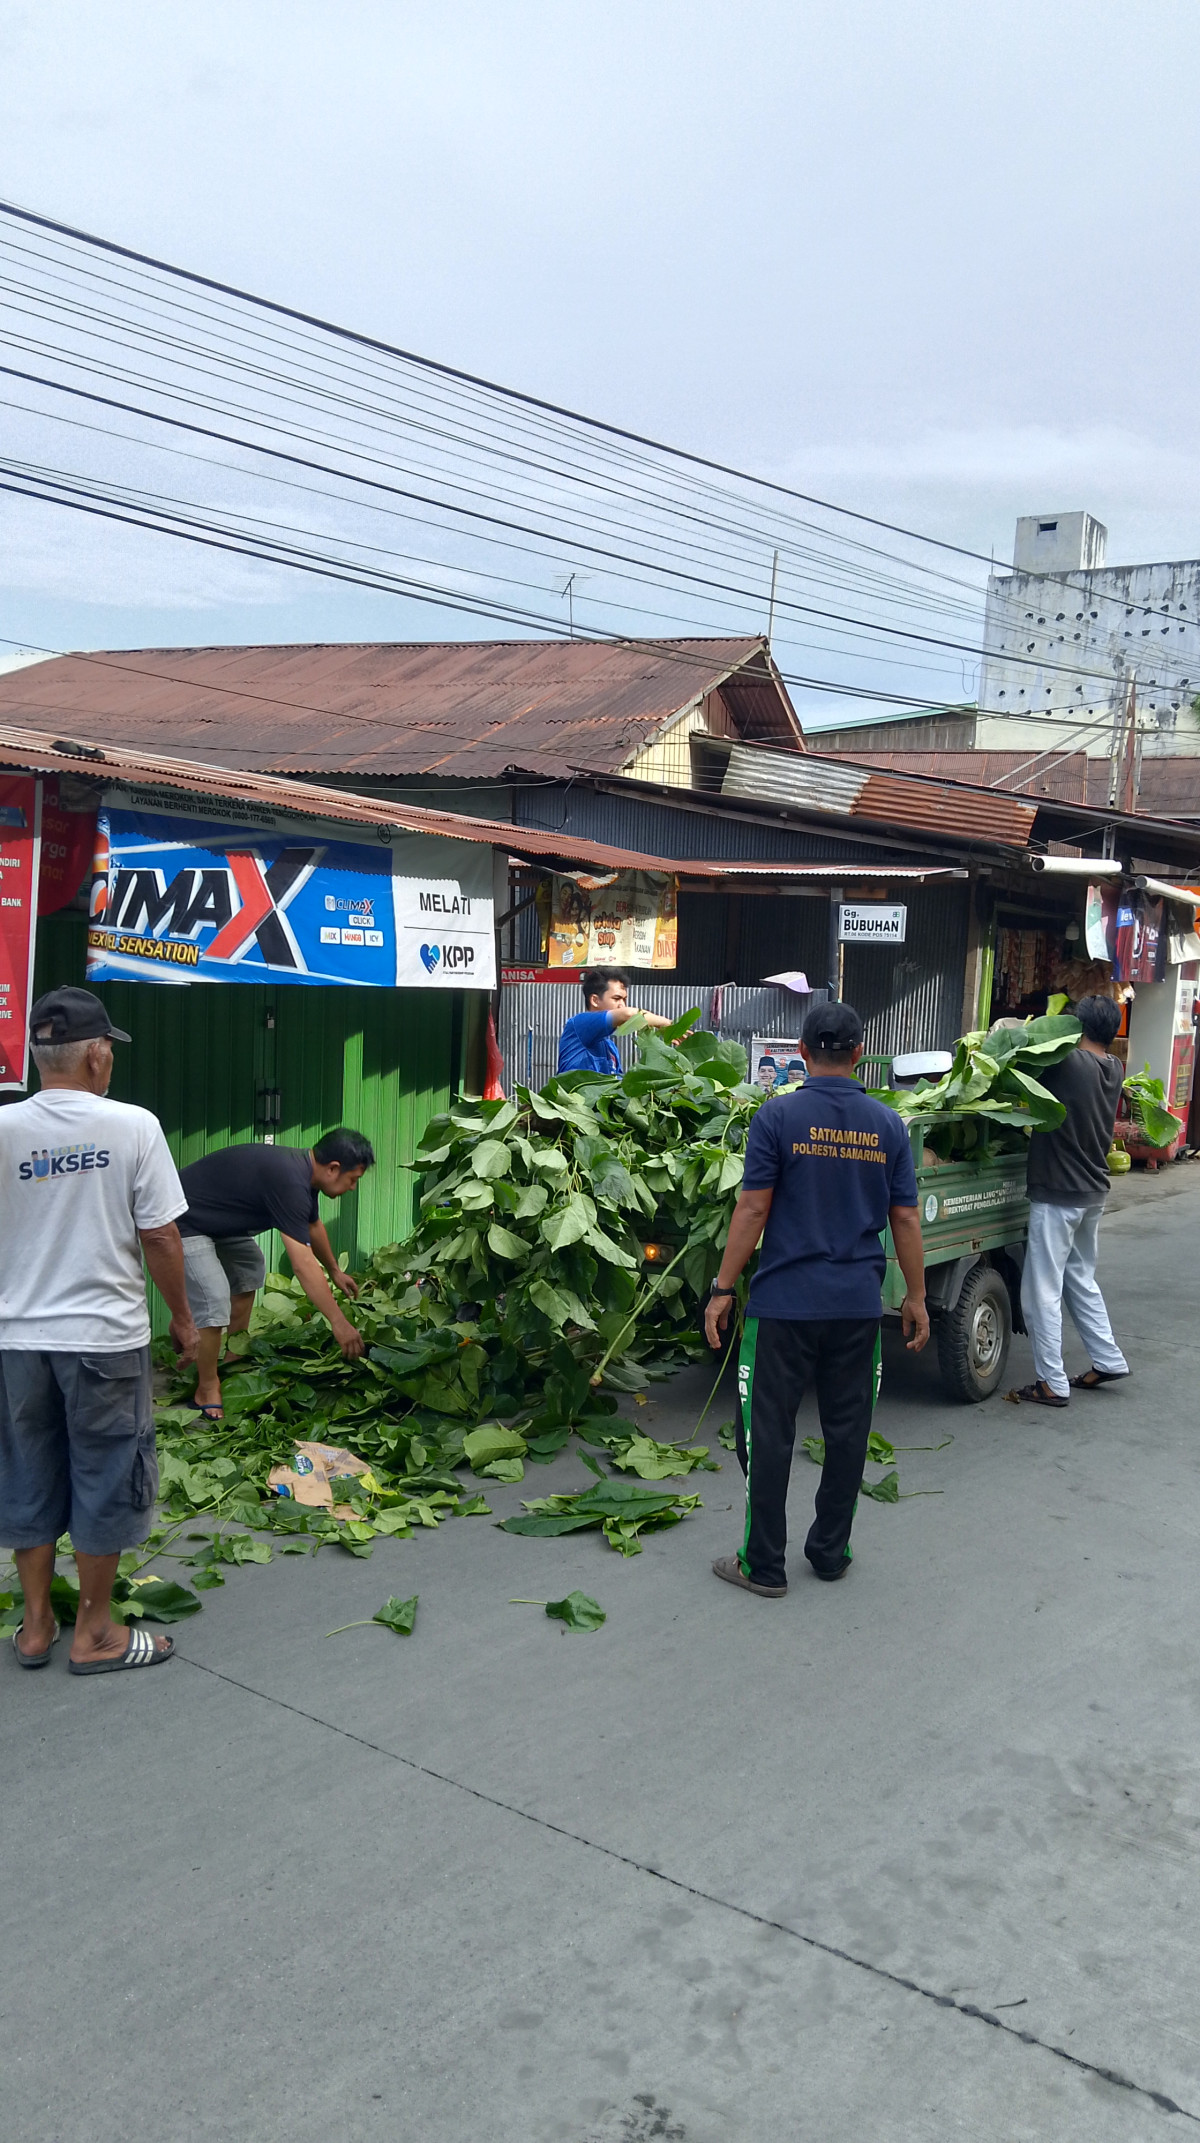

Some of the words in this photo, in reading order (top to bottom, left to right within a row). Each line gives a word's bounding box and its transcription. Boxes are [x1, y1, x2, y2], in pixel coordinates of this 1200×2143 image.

[131, 796, 163, 808] LAYANAN
[164, 801, 198, 813] BERHENTI
[198, 806, 231, 818] MEROKOK
[1, 897, 22, 907] BANK
[336, 897, 375, 914] CLIMAX
[419, 892, 471, 915] MELATI
[843, 909, 860, 918] Gg.
[353, 917, 371, 926] CLICK
[843, 919, 899, 932] BUBUHAN
[370, 934, 379, 942] ICY
[118, 935, 200, 965] SENSATION
[443, 945, 475, 968] KPP
[501, 970, 536, 981] ANISA
[809, 1126, 879, 1147] SATKAMLING
[792, 1143, 838, 1158] POLRESTA
[19, 1149, 110, 1181] SUKSES
[943, 1193, 983, 1207] KEMENTERIAN
[943, 1204, 974, 1216] DIREKTORAT
